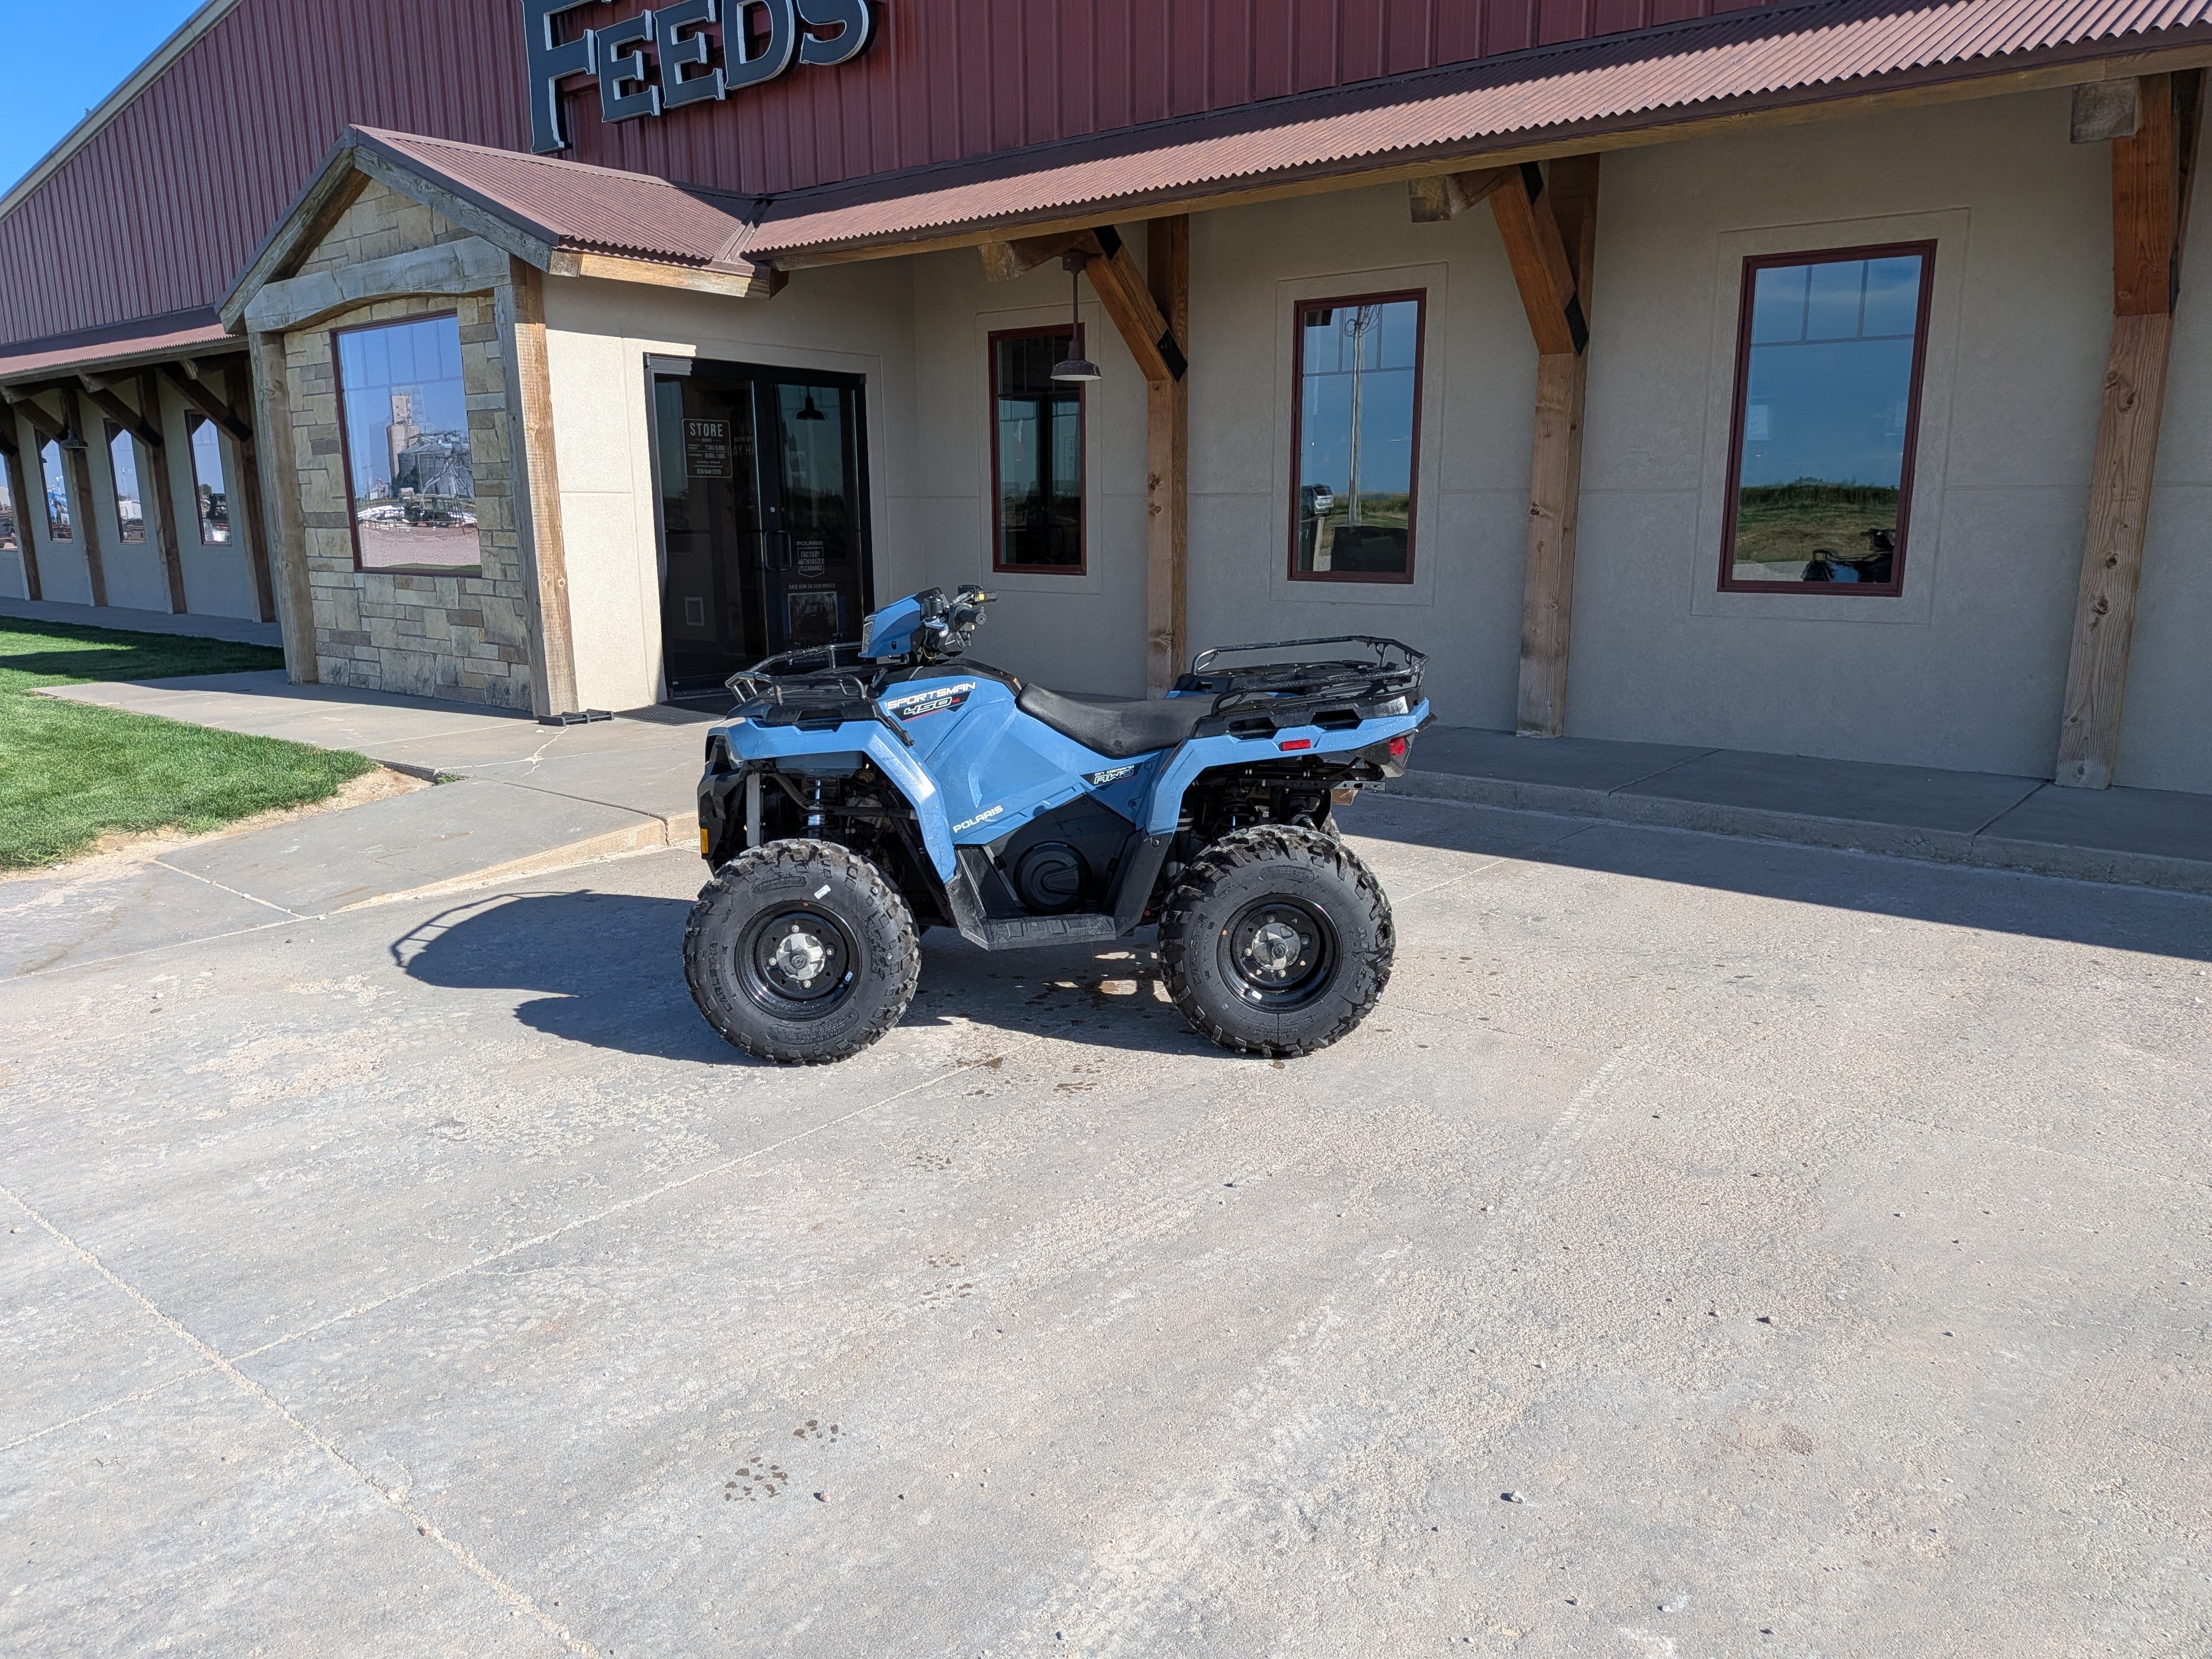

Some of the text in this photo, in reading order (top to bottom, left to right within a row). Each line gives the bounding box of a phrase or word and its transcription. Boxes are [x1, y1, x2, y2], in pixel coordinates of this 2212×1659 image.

[520, 0, 870, 154] FEEDS
[690, 422, 723, 437] STORE
[887, 681, 977, 710] SPORTSMAN
[904, 696, 953, 716] 450
[1094, 769, 1134, 784] AWD
[1107, 765, 1135, 774] DEMAND
[952, 805, 1004, 833] POLARIS
